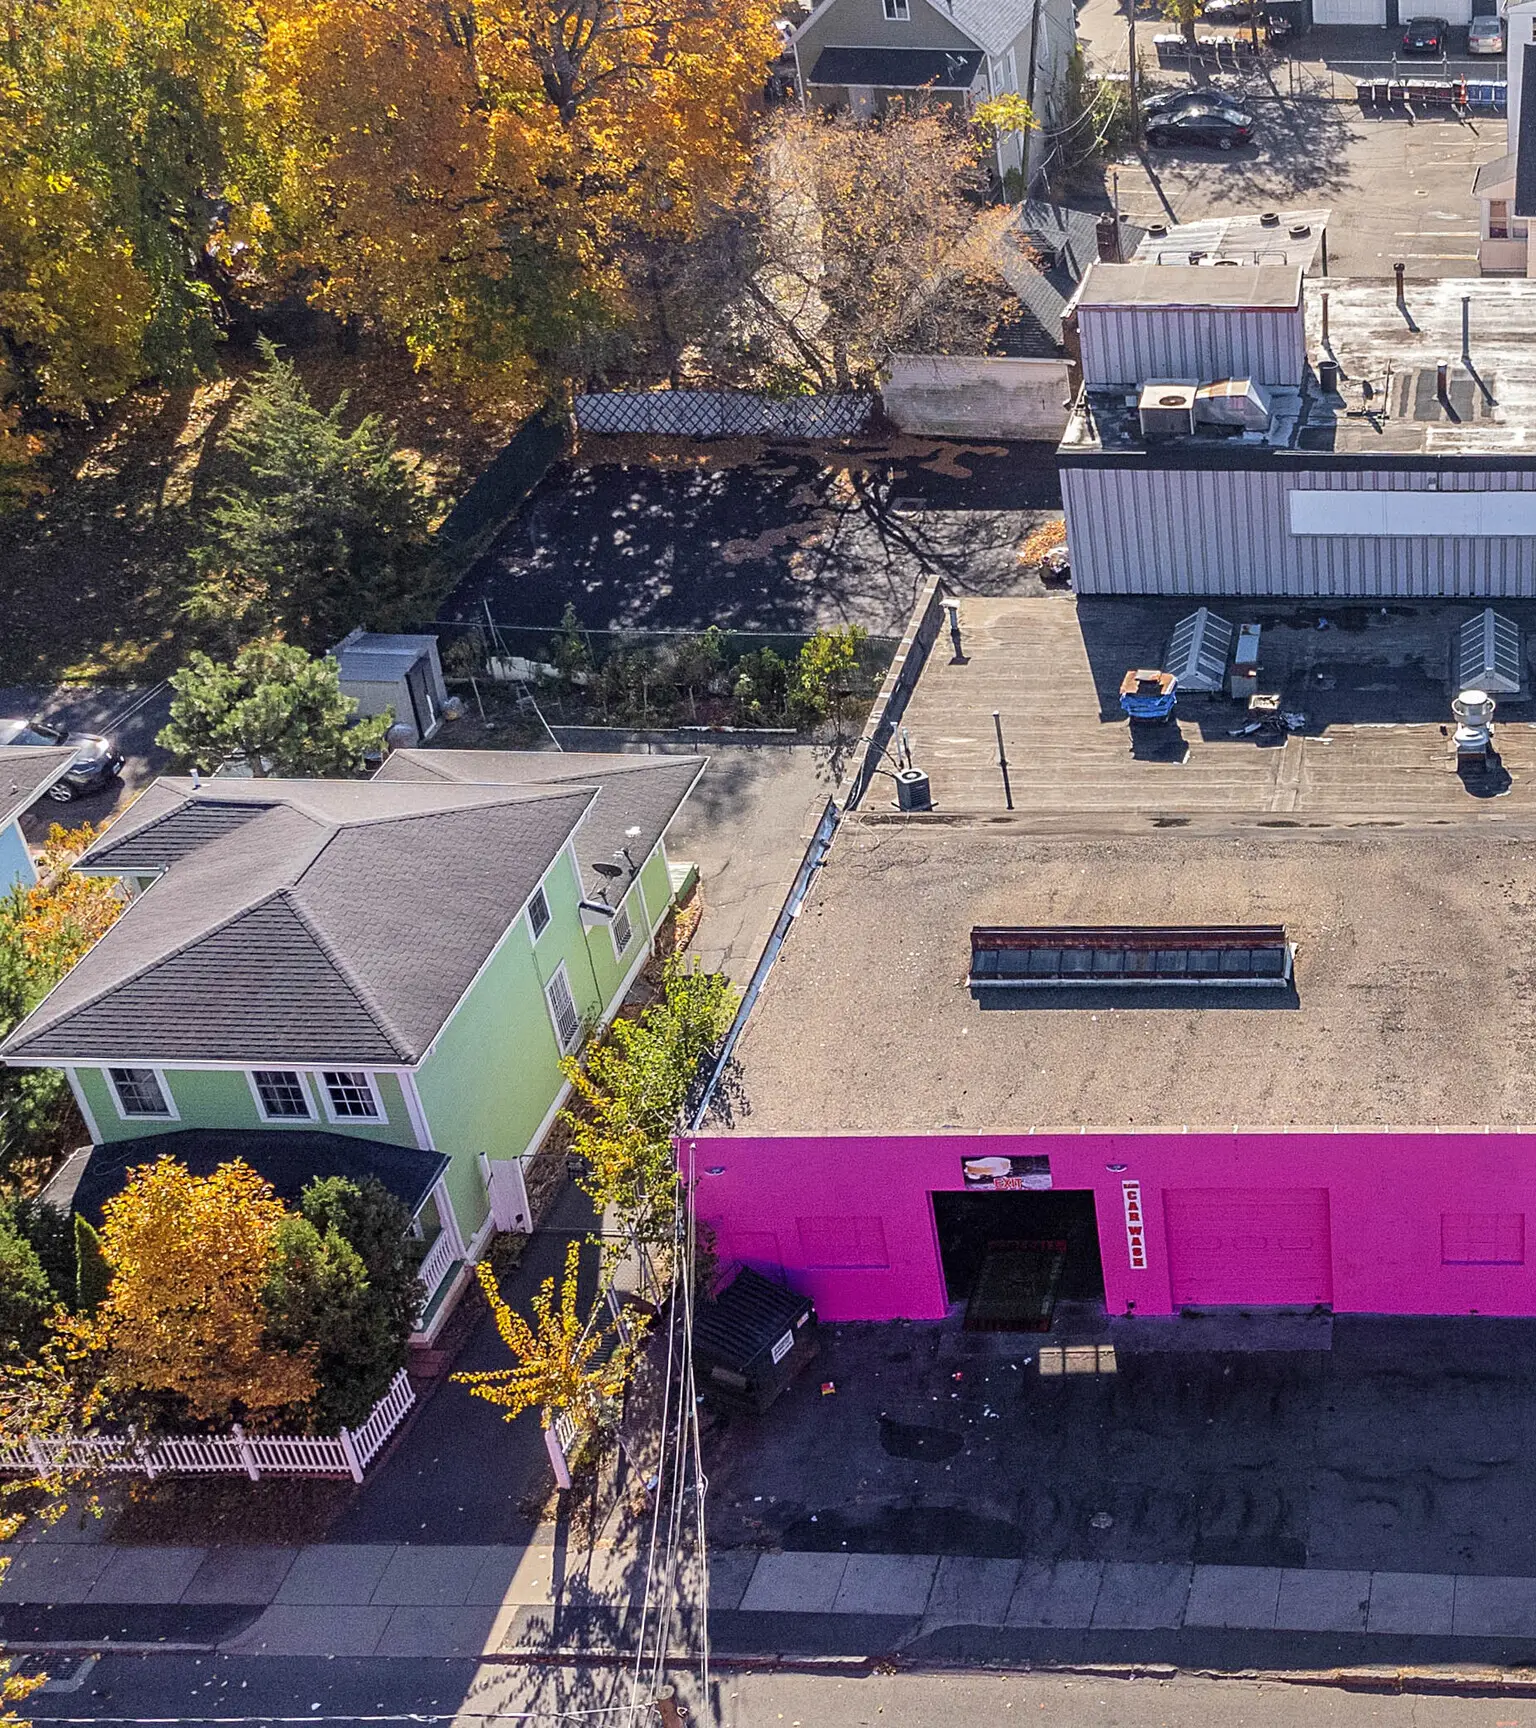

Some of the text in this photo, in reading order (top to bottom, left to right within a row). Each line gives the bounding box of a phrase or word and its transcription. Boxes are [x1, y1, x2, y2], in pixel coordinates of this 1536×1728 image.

[993, 1177, 1022, 1189] EXIT
[1127, 1190, 1140, 1221] CAR
[1127, 1226, 1144, 1267] WASH
